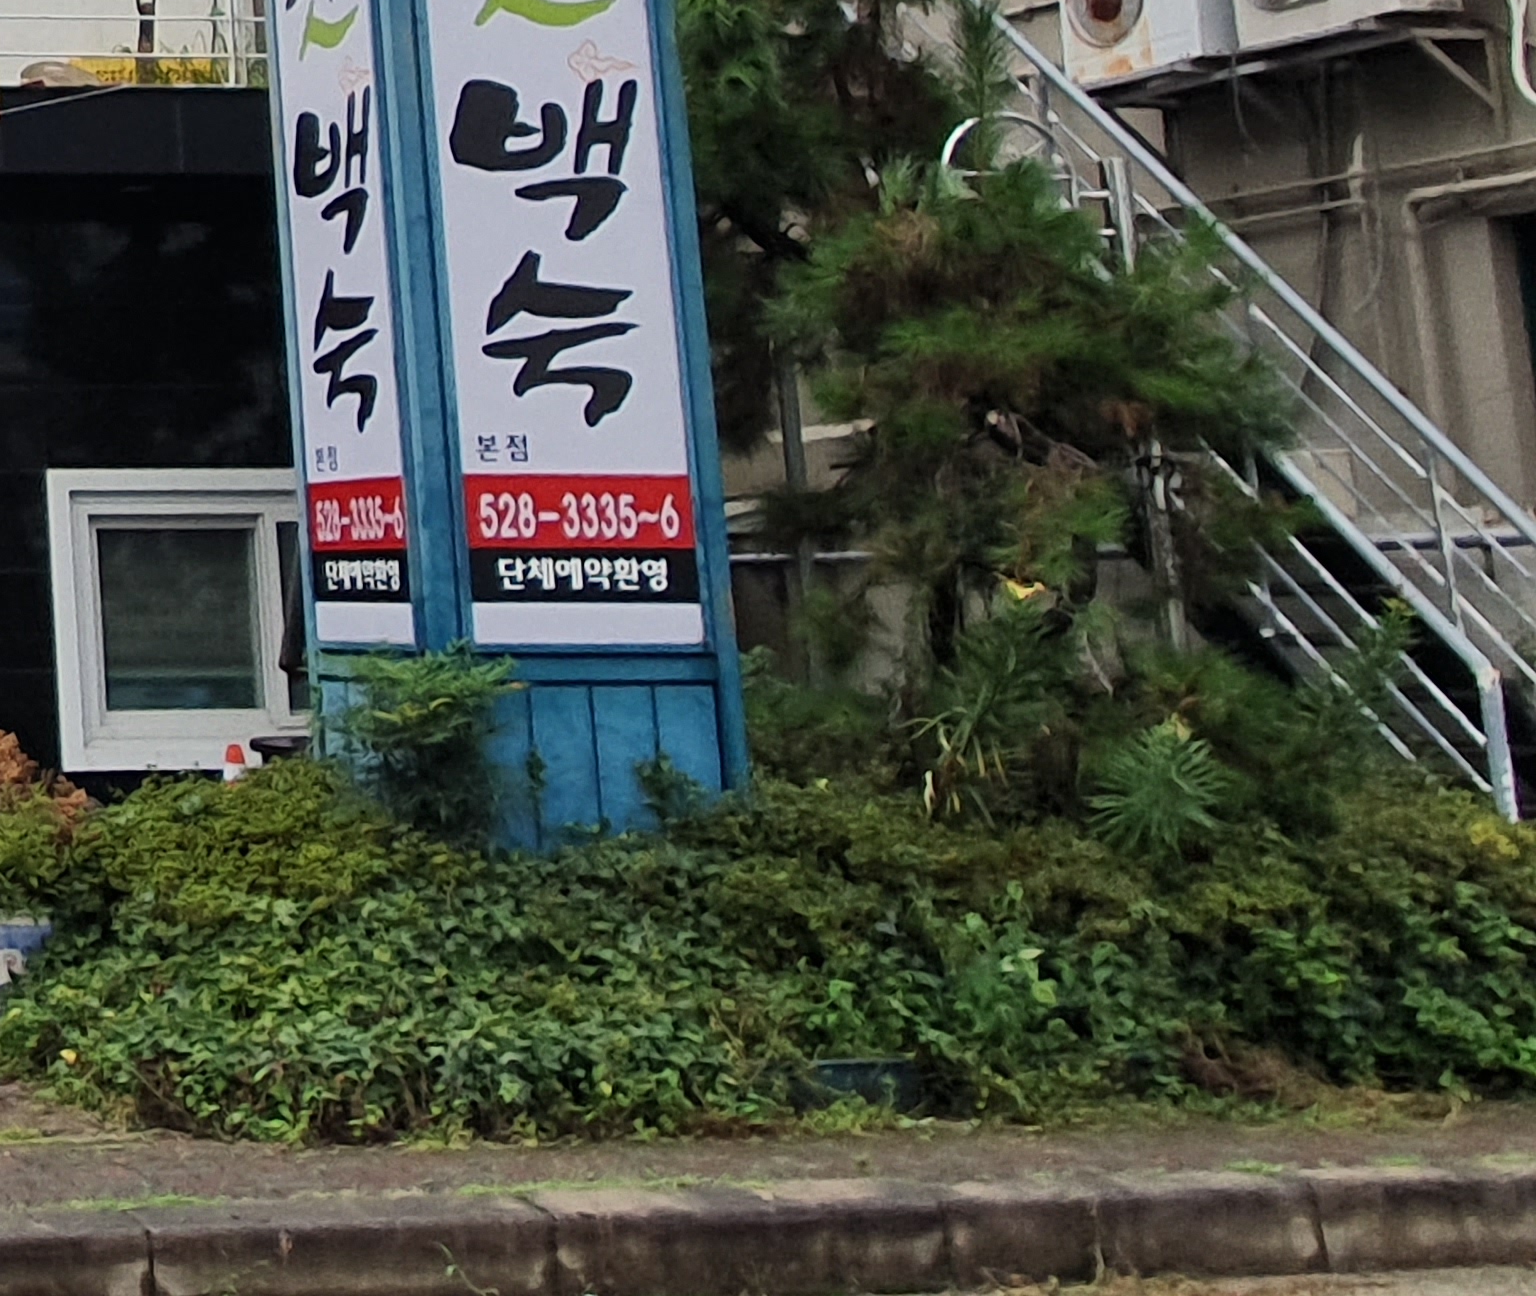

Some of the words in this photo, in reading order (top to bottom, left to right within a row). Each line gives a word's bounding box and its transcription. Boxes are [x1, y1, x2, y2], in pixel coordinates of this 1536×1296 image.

[293, 84, 378, 433] 백숙
[449, 79, 641, 429] 백숙
[475, 432, 530, 463] 본점
[478, 491, 680, 541] 528-3335~6
[325, 558, 401, 592] 단체예약환영
[497, 557, 669, 593] 단체예약환영
